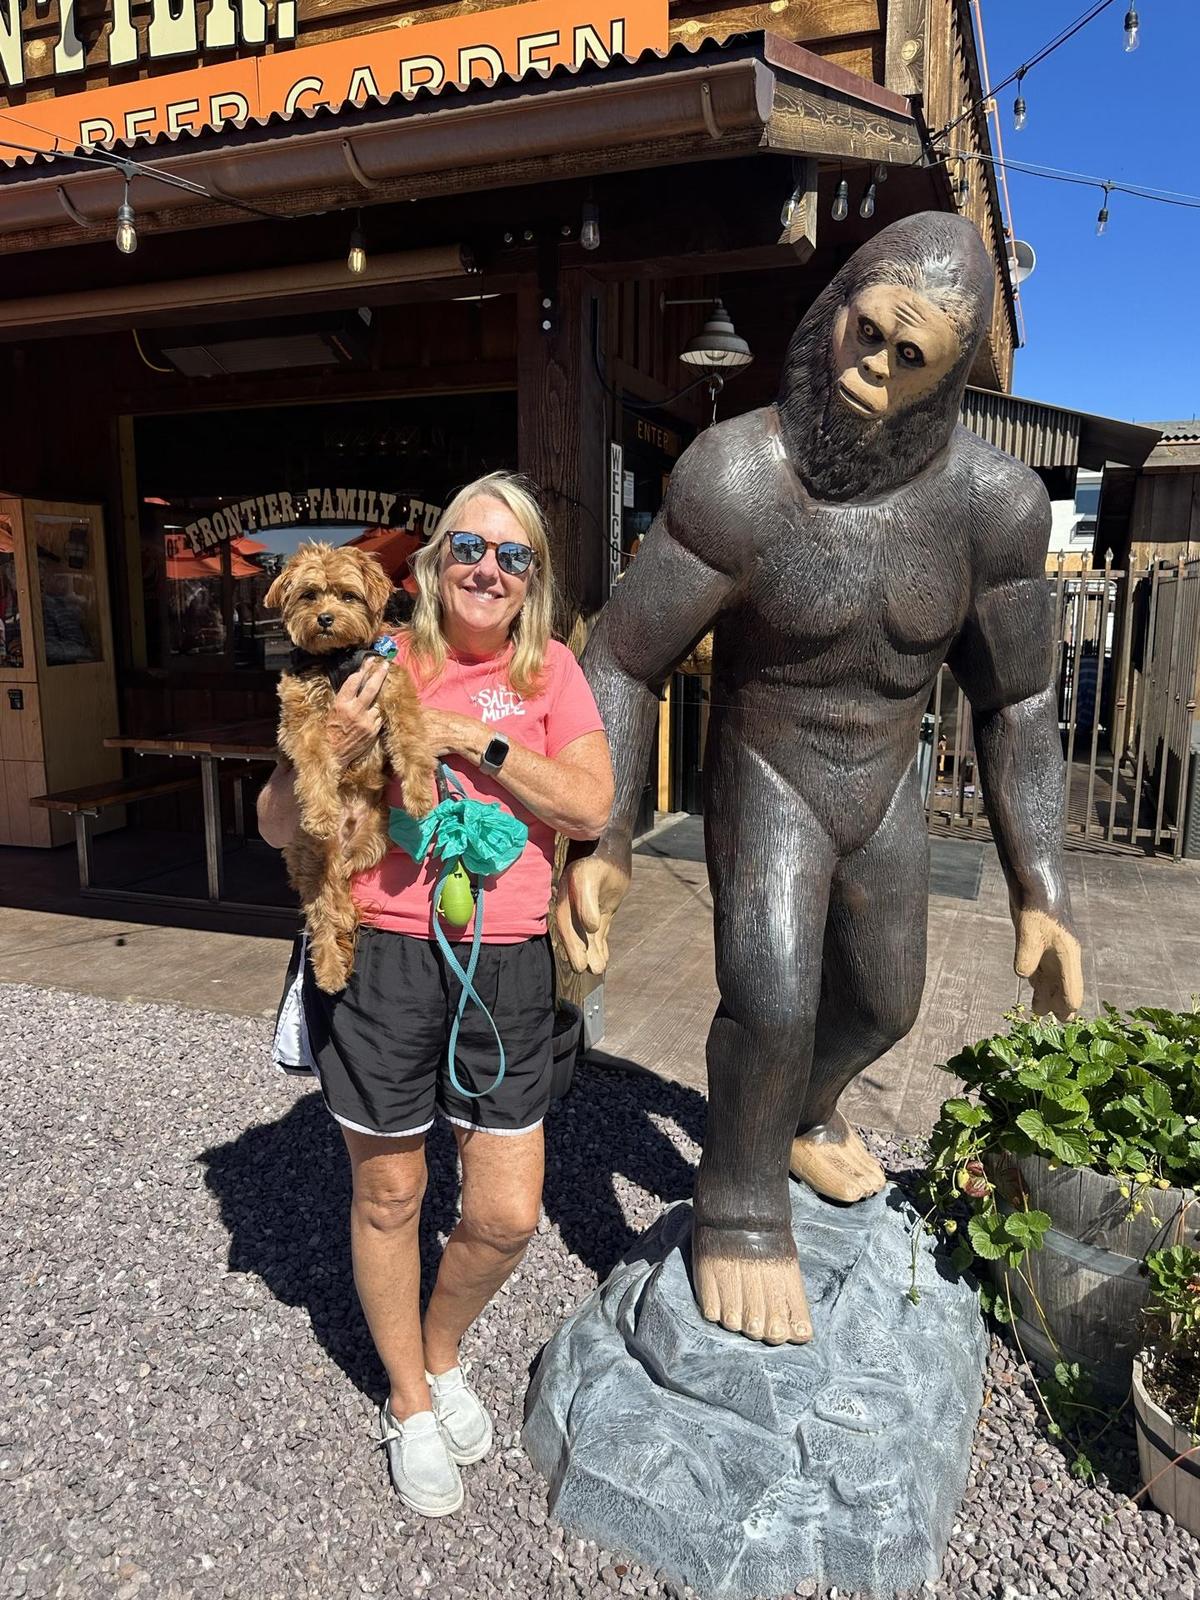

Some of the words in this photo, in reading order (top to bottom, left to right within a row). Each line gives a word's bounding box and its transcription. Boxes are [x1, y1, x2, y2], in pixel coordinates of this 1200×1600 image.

[637, 419, 669, 449] ENTER
[185, 491, 299, 553] FRONTIER
[307, 488, 397, 525] FAMILY
[406, 499, 442, 536] FU
[611, 447, 621, 588] WELCOM
